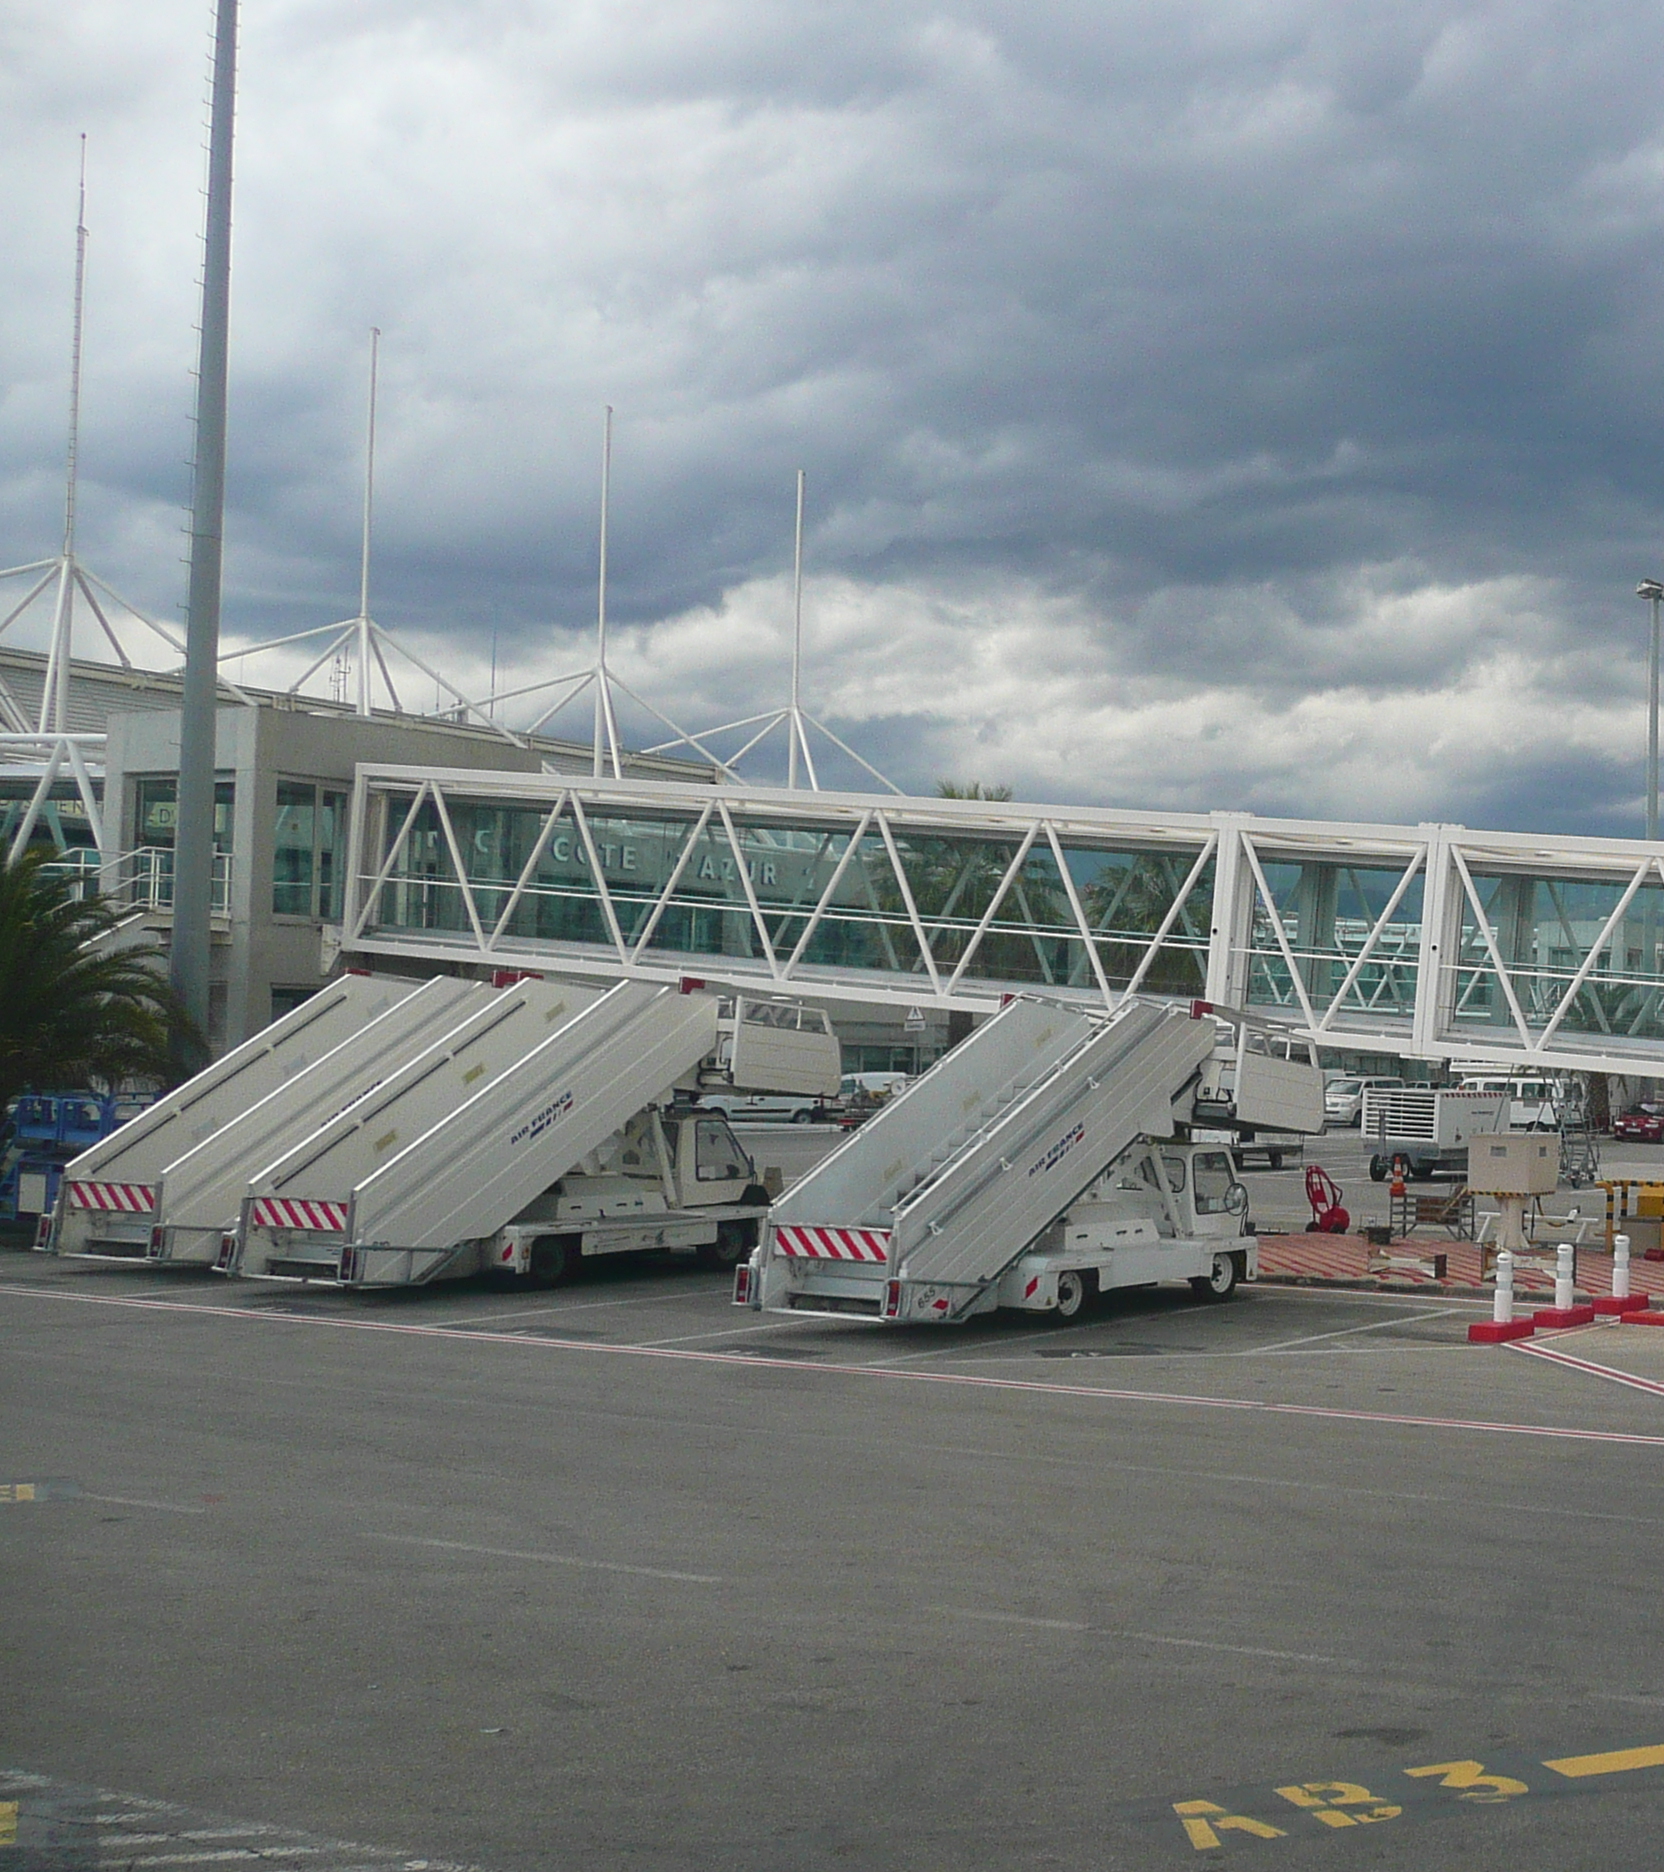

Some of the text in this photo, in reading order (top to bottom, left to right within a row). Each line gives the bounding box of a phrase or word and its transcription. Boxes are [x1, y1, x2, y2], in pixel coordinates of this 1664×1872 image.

[511, 1090, 572, 1145] AIR FRANCE
[1029, 1121, 1084, 1177] AIR FRANCE
